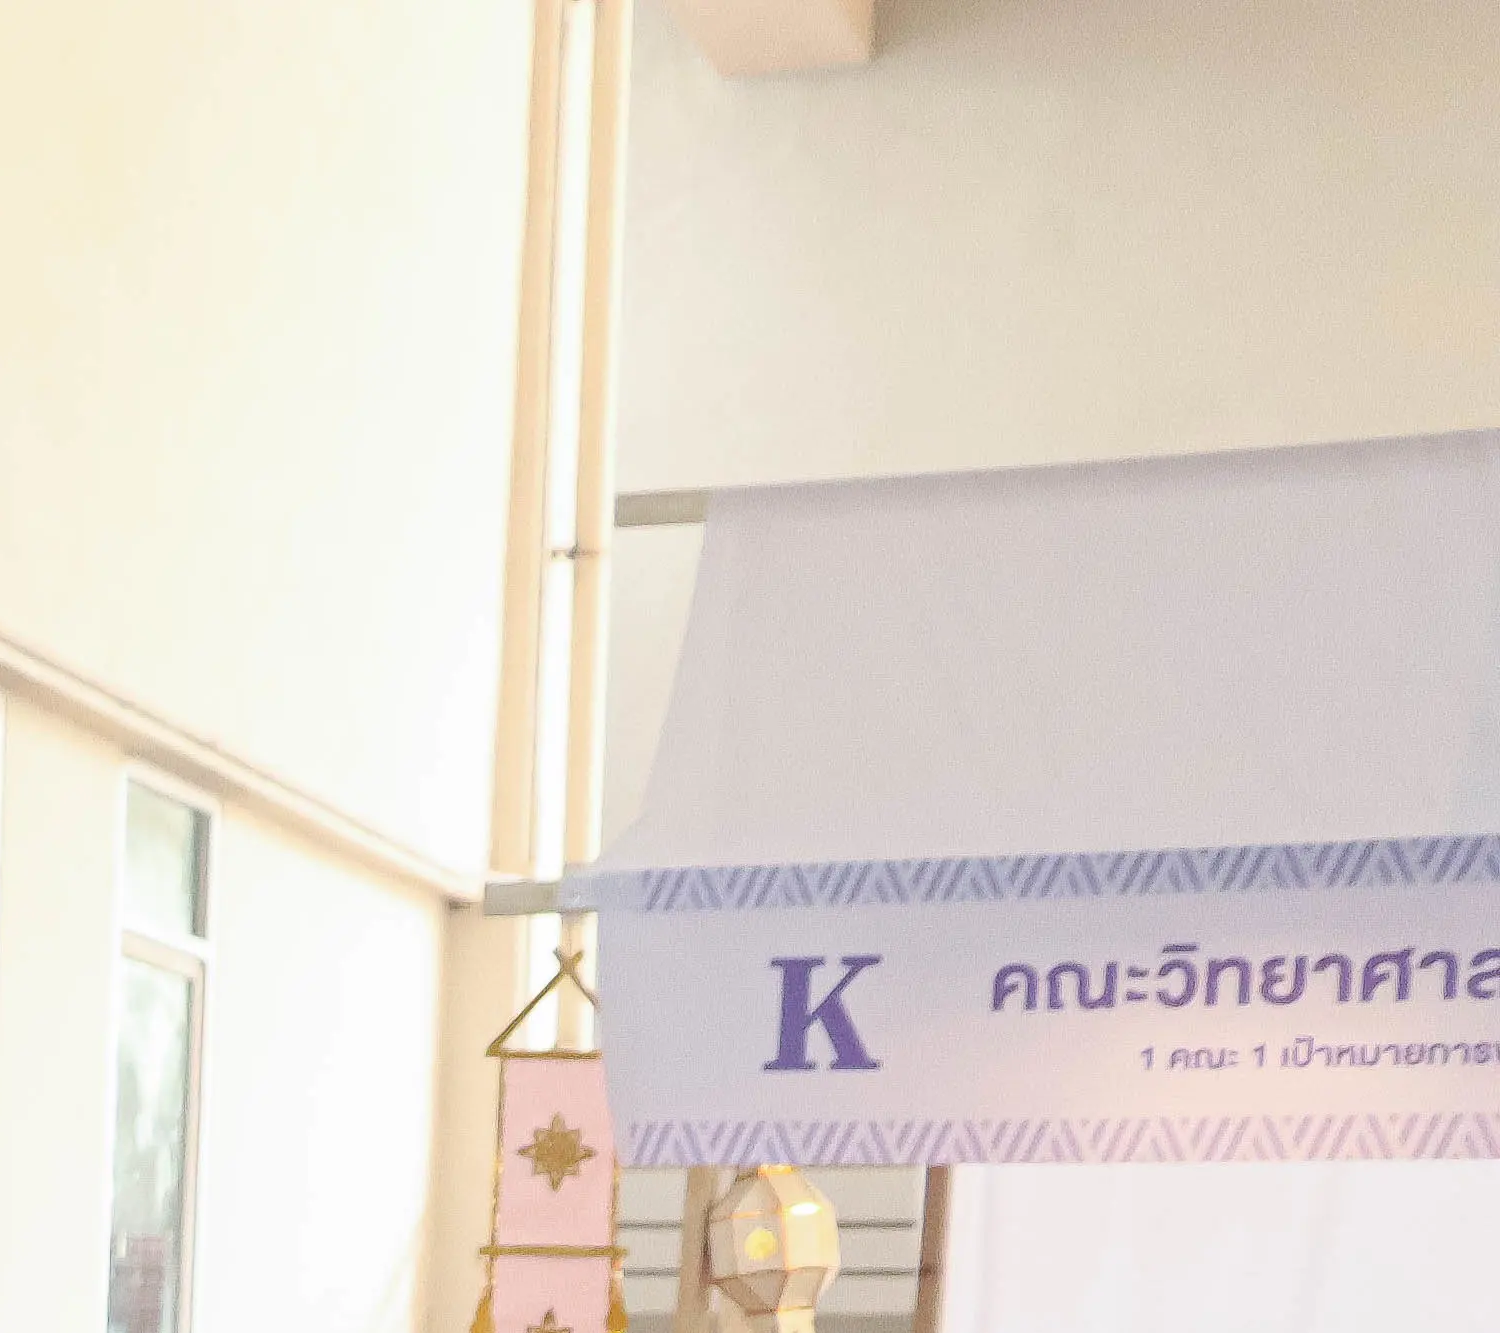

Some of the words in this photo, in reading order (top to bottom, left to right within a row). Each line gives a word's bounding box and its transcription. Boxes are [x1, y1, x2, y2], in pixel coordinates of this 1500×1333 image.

[762, 954, 882, 1072] K
[1139, 1045, 1155, 1071] 1
[1166, 1047, 1239, 1071] คณะ
[1252, 1043, 1268, 1069] 1
[1280, 1034, 1500, 1069] เป้าหมายการ
